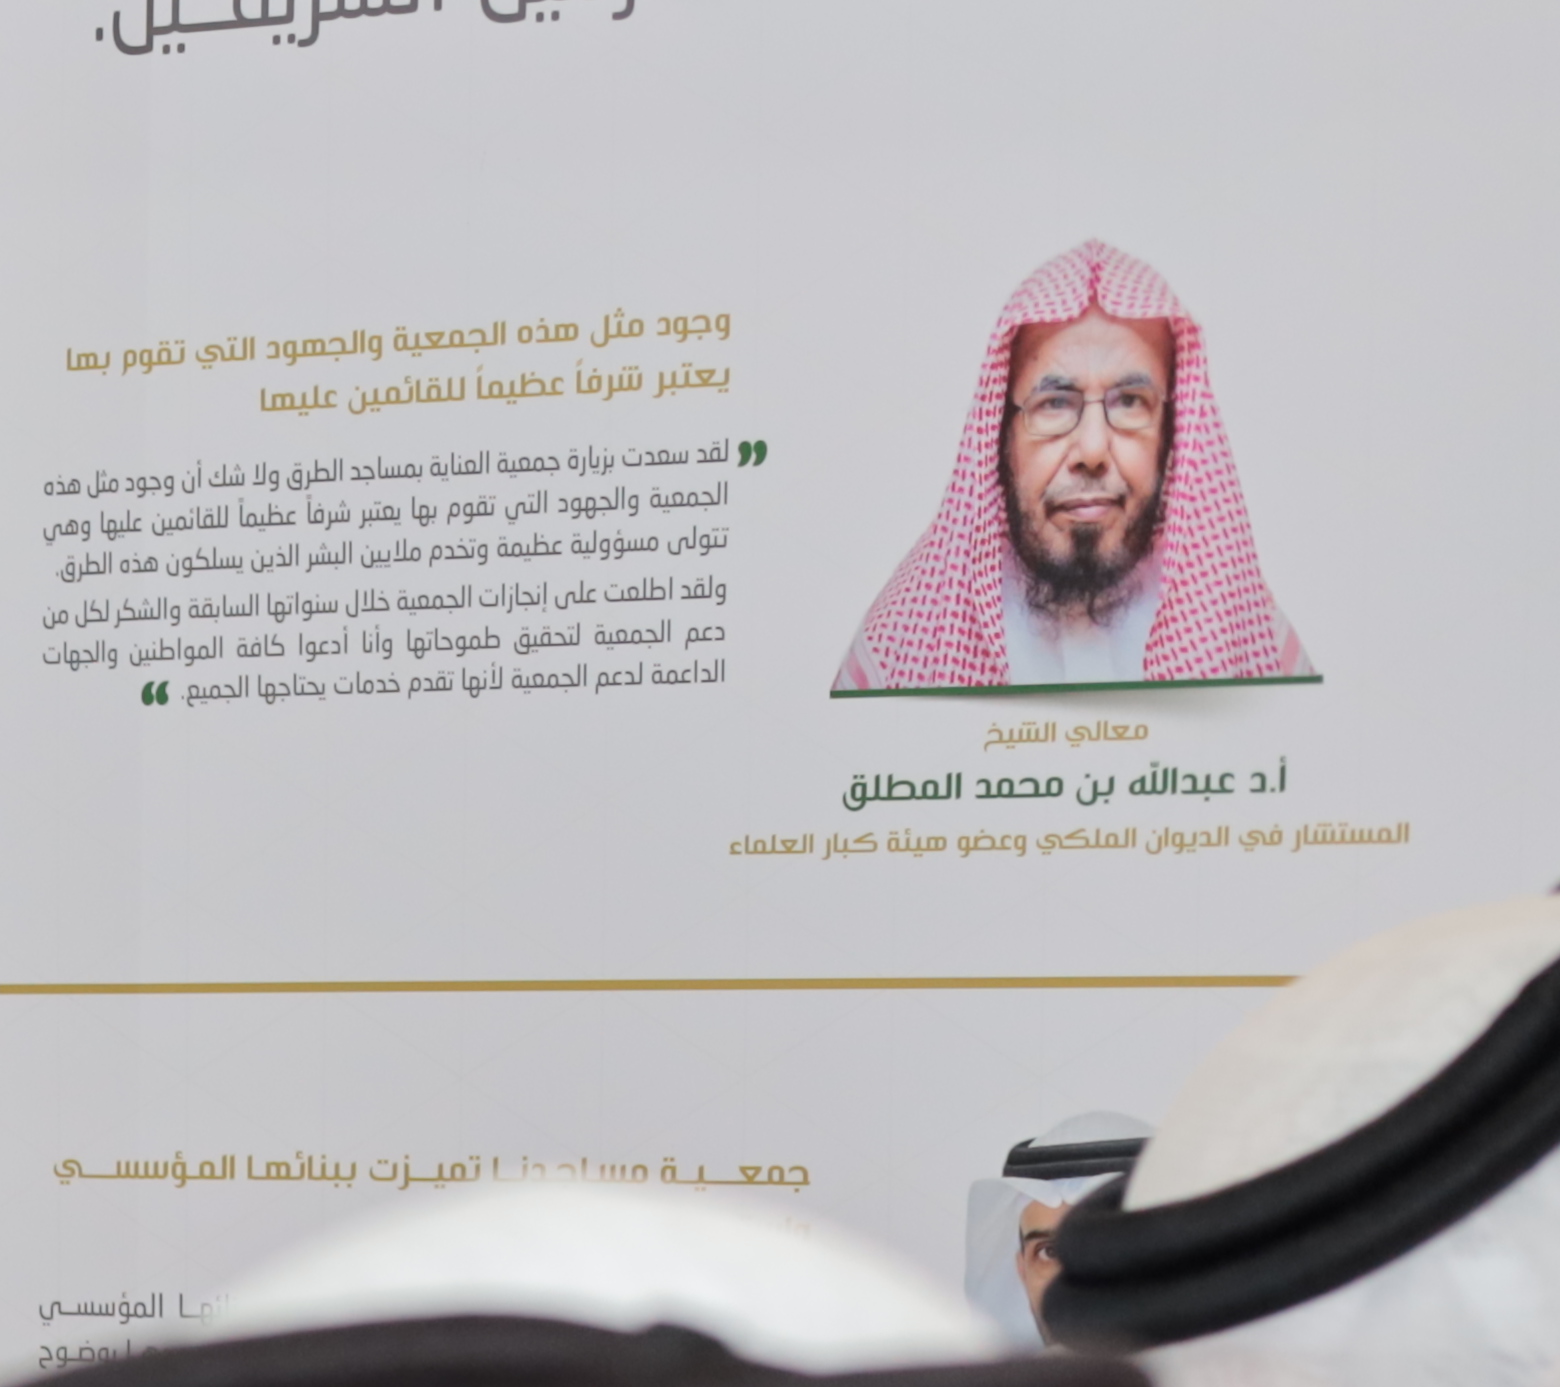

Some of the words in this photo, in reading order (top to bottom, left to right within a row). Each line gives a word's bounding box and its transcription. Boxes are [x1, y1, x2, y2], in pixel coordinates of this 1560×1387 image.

[392, 320, 507, 358] الجمعية
[516, 317, 580, 345] هذه
[589, 306, 645, 349] مثل
[655, 312, 732, 344] وجود
[65, 347, 112, 376] بها
[121, 339, 186, 376] تقوم
[194, 335, 256, 370] التي
[265, 328, 384, 367] والجهود
[347, 375, 467, 416] للقائمين
[475, 364, 565, 406] عظيماً
[575, 358, 644, 402] شرفاً
[652, 362, 731, 399] يعتبر
[259, 384, 338, 417] عليها
[429, 449, 490, 482] العناية
[496, 452, 561, 479] جمعية
[567, 444, 615, 478] بزيارة
[621, 447, 689, 468] سعدت
[696, 437, 730, 465] لقد
[43, 473, 82, 497] هذه
[86, 469, 120, 500] مثل
[124, 474, 175, 499] وجود
[181, 459, 202, 495] أن
[207, 463, 246, 488] شك
[252, 461, 280, 493] ولا
[286, 457, 344, 492] الطرق
[349, 455, 423, 486] بمساجد
[306, 494, 351, 532] شرفاً
[411, 495, 438, 528] بها
[446, 495, 497, 526] تقوم
[504, 489, 548, 526] التي
[557, 485, 640, 520] والجهود
[649, 480, 729, 514] الجمعية
[100, 509, 143, 542] عليها
[151, 504, 229, 537] للقائمين
[238, 497, 297, 532] عظيماً
[358, 501, 402, 530] يعتبر
[42, 518, 92, 546] وهي
[496, 532, 563, 562] عظيمة
[570, 529, 660, 561] مسؤولية
[666, 524, 730, 557] تتولى
[55, 551, 113, 584] الطرق.
[119, 552, 159, 574] هذه
[165, 546, 244, 579] يسلكون
[250, 542, 300, 574] الذين
[305, 540, 353, 574] البشر
[360, 537, 422, 569] ملايين
[428, 537, 489, 568] وتخدم
[345, 587, 391, 619] خلال
[396, 584, 472, 616] الجمعية
[478, 581, 548, 615] إنجازات
[554, 579, 597, 611] على
[603, 576, 674, 603] اطلعت
[680, 574, 727, 607] ولقد
[42, 606, 69, 631] من
[74, 598, 110, 629] لكل
[113, 596, 181, 629] والشكر
[187, 592, 260, 624] السابقة
[266, 591, 339, 624] سنواتها
[236, 633, 286, 659] كافة
[298, 625, 348, 663] أدعوا
[362, 624, 393, 661] وأنا
[406, 625, 501, 660] طموحاتها
[513, 621, 581, 656] لتحقيق
[594, 618, 672, 651] الجمعية
[684, 625, 726, 651] دعم
[42, 639, 118, 673] والجهات
[129, 635, 224, 668] المواطنين
[333, 670, 401, 695] خدمات
[407, 670, 455, 700] تقدم
[461, 661, 503, 699] لأنها
[510, 662, 588, 695] الجمعية
[594, 661, 644, 695] لدعم
[651, 658, 726, 686] الداعمة
[181, 674, 249, 708] الجميع.
[257, 672, 326, 706] يحتاجها
[983, 721, 1057, 752] الشيخ
[1064, 720, 1149, 748] معالي
[974, 775, 1065, 800] محمد
[1075, 772, 1116, 807] بن
[1248, 755, 1287, 794] أ.د
[841, 771, 963, 813] المطلق
[728, 833, 815, 856] العلماء
[821, 831, 879, 861] كبار
[886, 827, 948, 858] هيئة
[956, 828, 1028, 859] وعضو
[1035, 826, 1138, 856] الملكي
[1144, 825, 1231, 856] الديوان
[1237, 823, 1284, 852] في
[1291, 821, 1411, 853] المستشار
[246, 1151, 357, 1189] ببنائها
